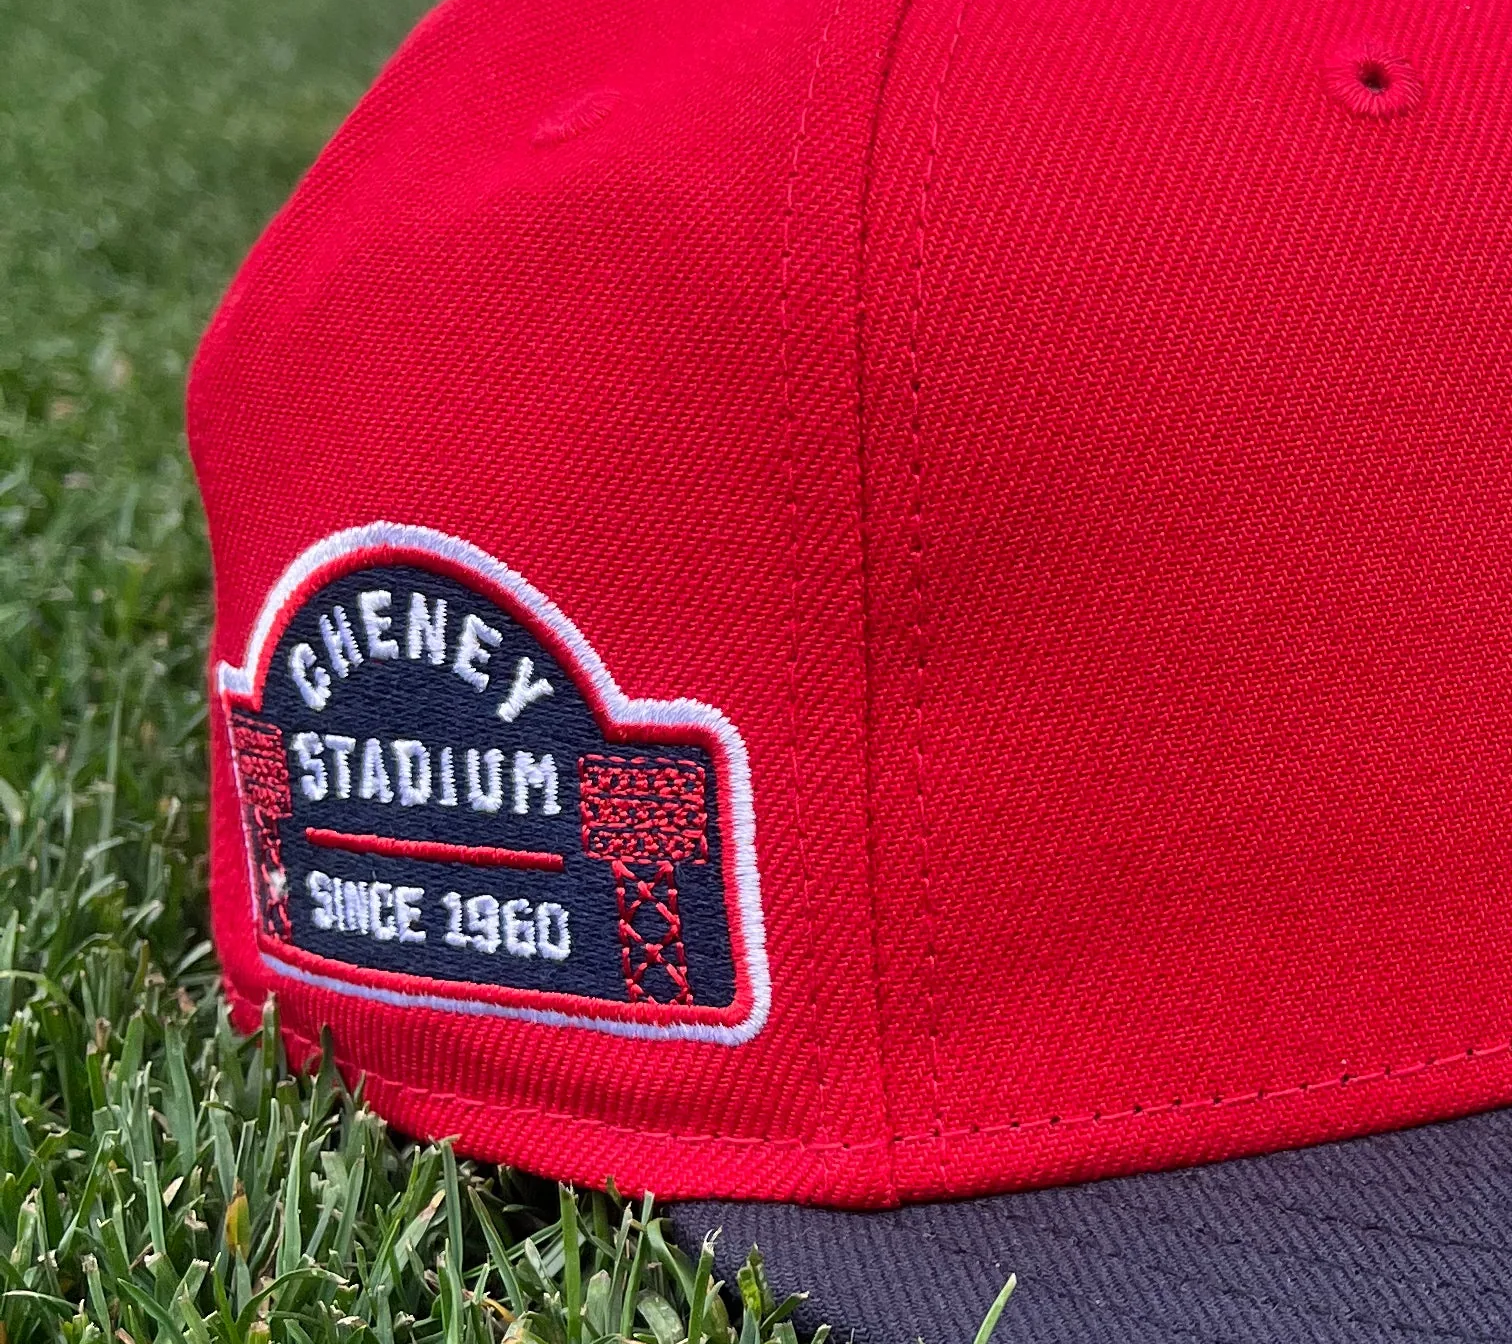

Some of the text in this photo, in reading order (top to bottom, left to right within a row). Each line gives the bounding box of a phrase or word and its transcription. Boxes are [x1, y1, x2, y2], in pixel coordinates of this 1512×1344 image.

[289, 589, 554, 723] CHENEY
[290, 731, 562, 815] STADIUM
[306, 870, 572, 961] SINCE 1960
